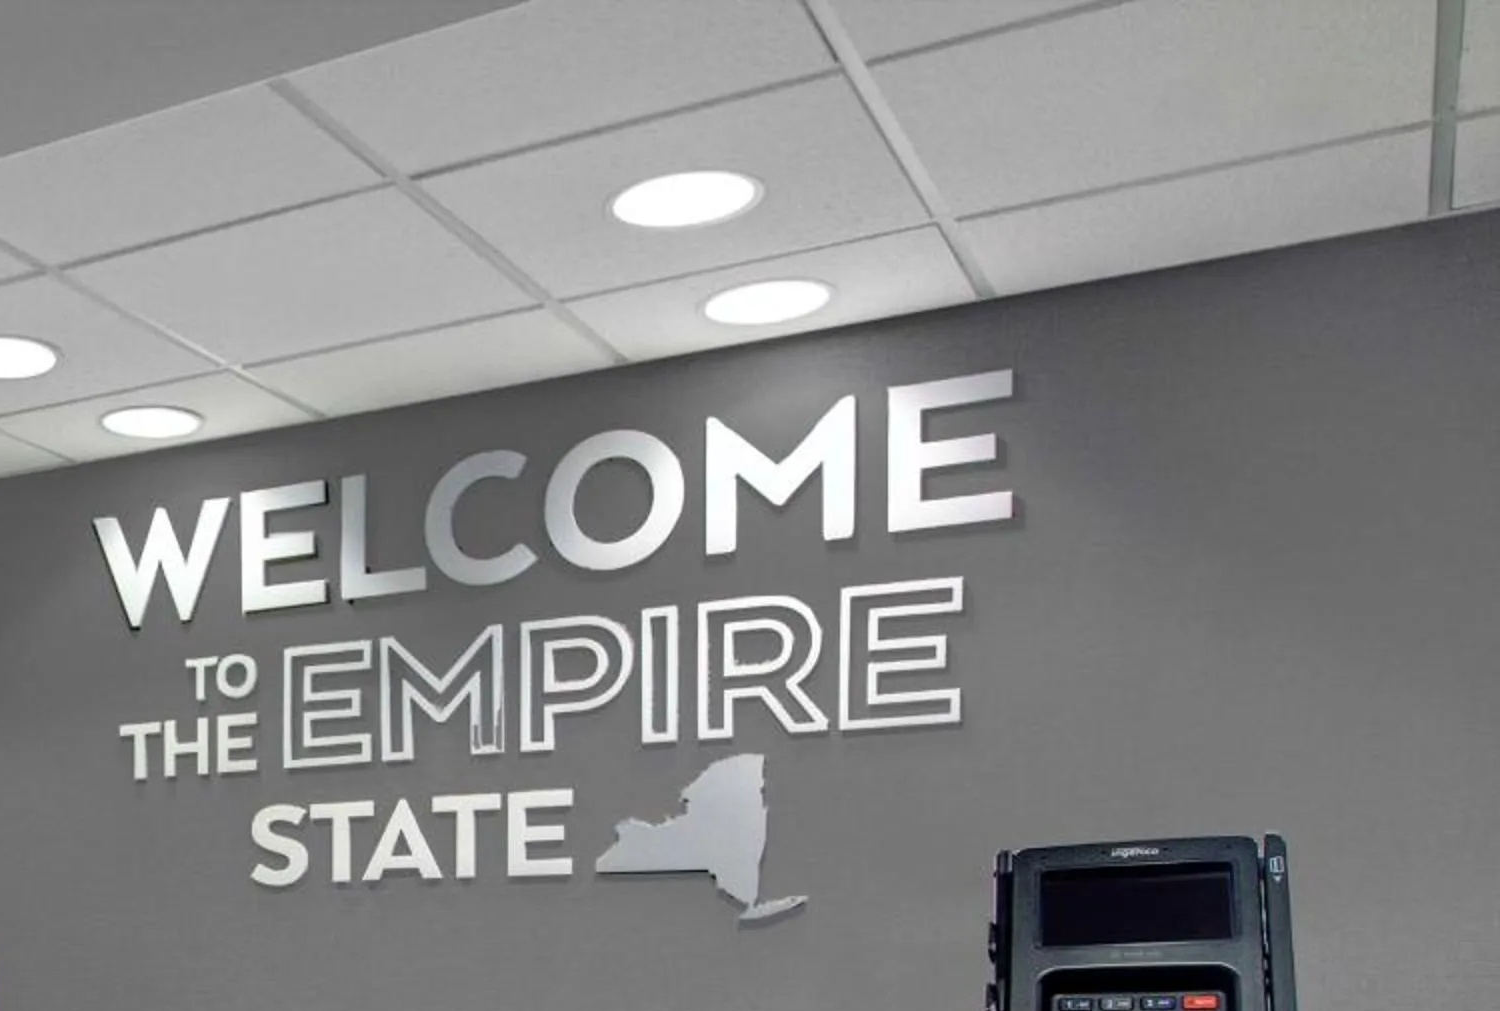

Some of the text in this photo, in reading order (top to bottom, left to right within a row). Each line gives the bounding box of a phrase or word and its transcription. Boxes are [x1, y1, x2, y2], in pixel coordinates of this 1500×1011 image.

[93, 369, 1013, 629] WELCOME
[185, 654, 257, 701] TO
[283, 576, 964, 770] EMPIRE
[119, 712, 258, 780] THE
[251, 789, 574, 886] STATE
